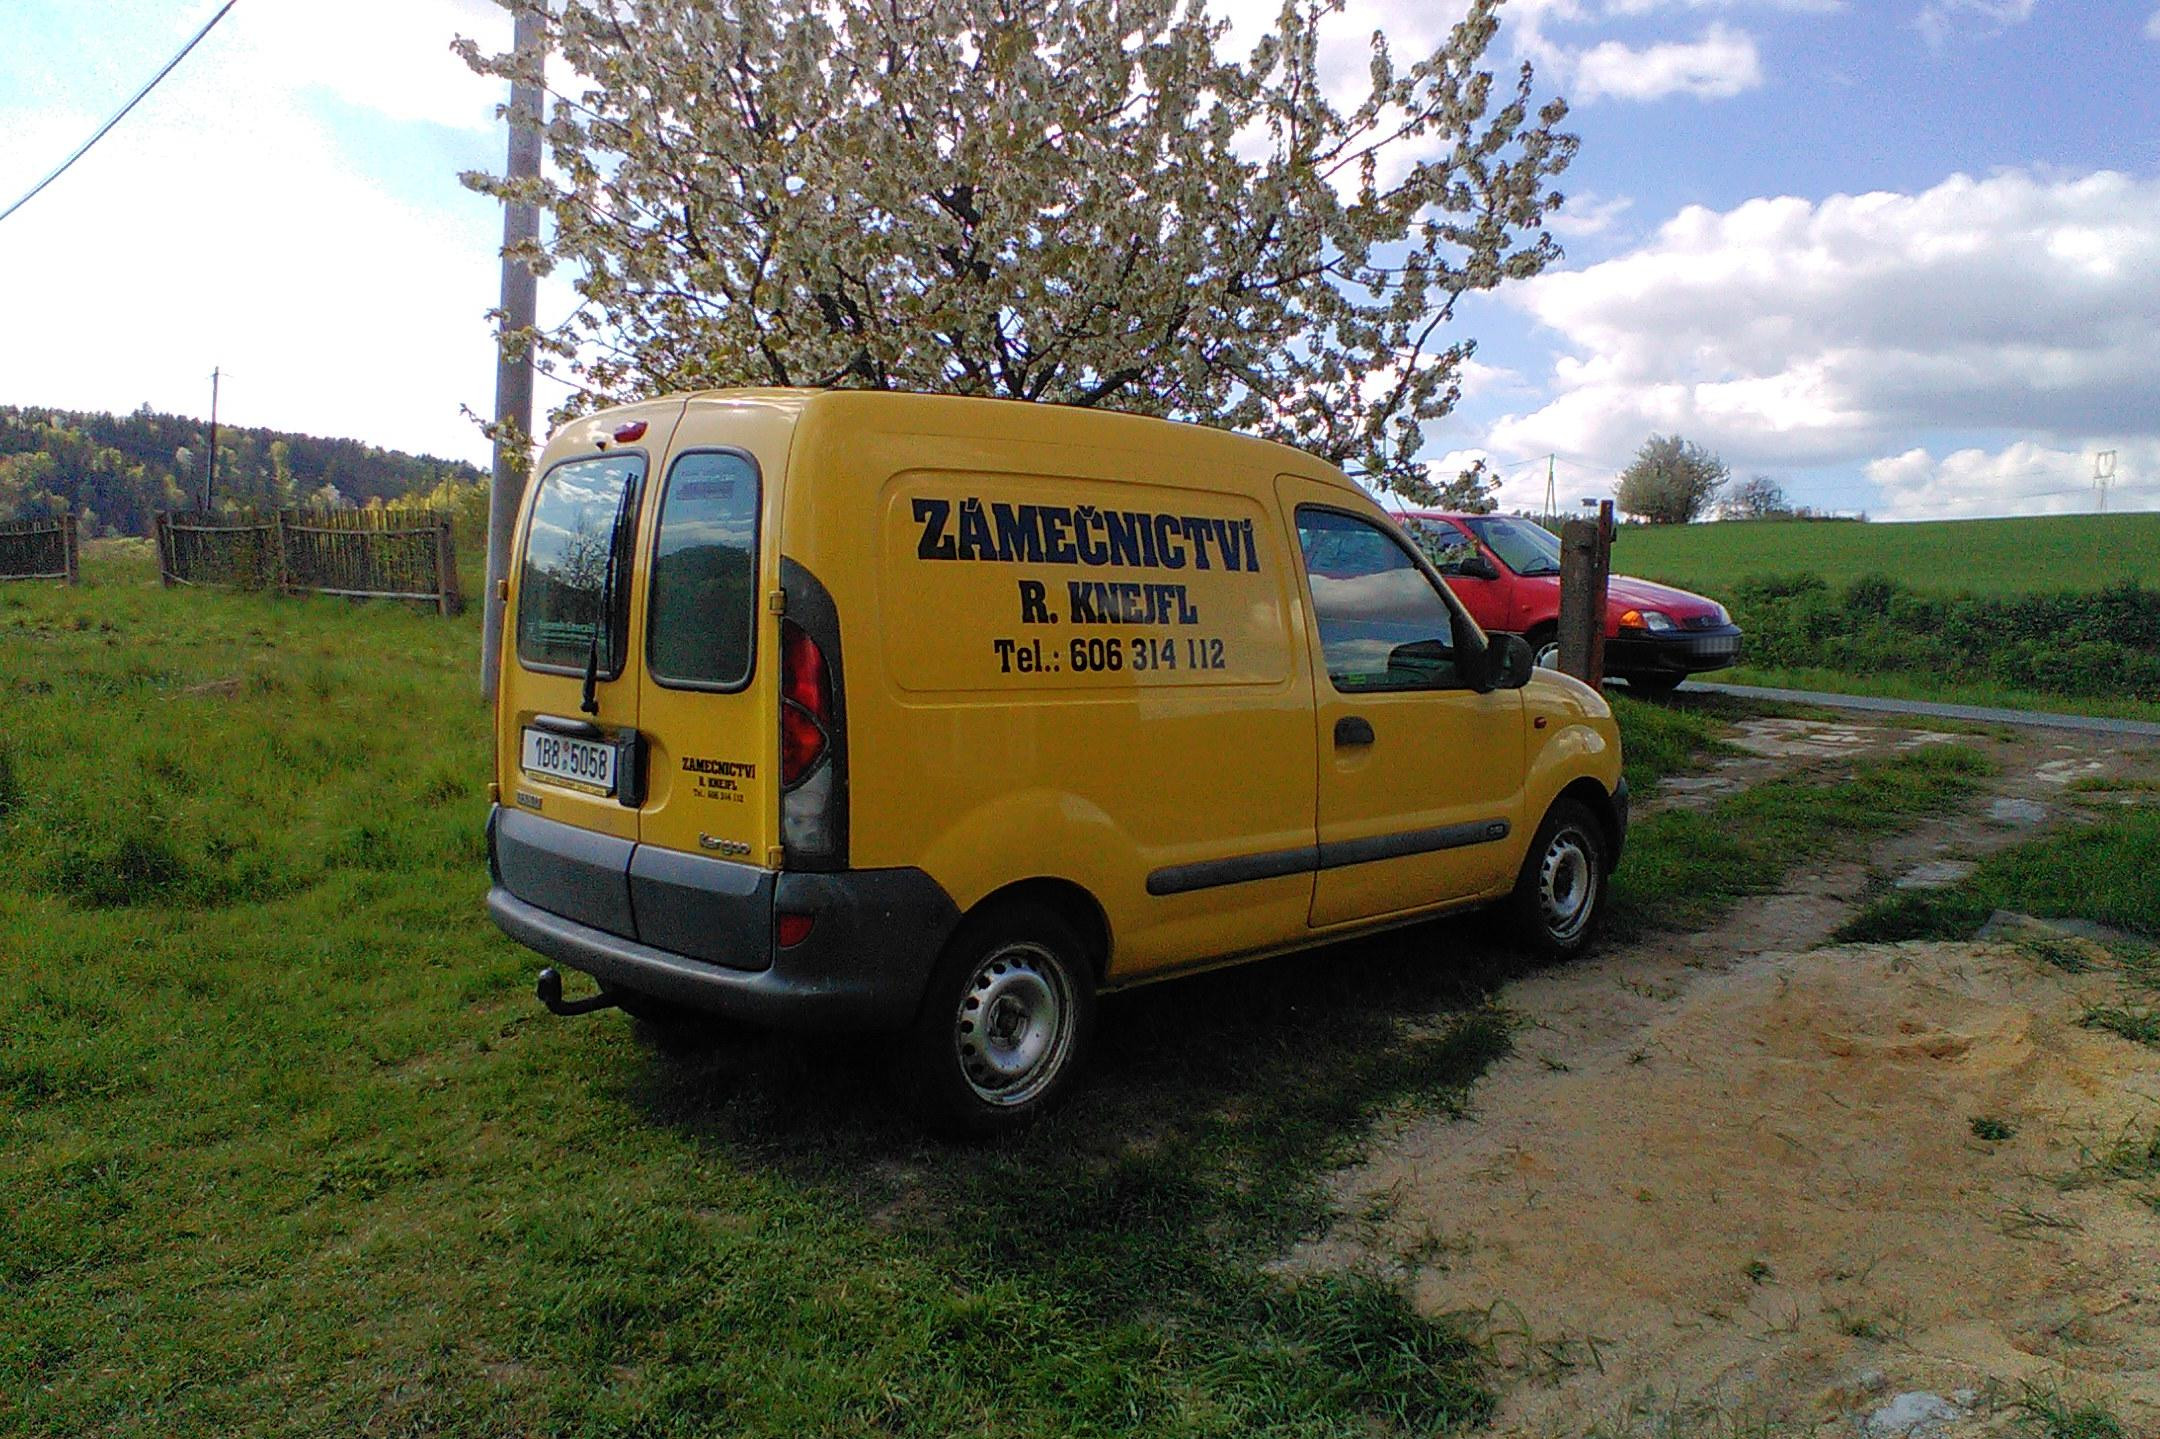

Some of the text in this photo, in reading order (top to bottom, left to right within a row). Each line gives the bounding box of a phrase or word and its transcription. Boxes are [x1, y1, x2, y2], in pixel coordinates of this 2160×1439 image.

[912, 497, 1260, 573] ZÁMEČNICTVÍ
[1018, 579, 1198, 625] R. KNEJFL
[994, 638, 1226, 673] Tel.: 606 314 112
[570, 743, 608, 780] 5058
